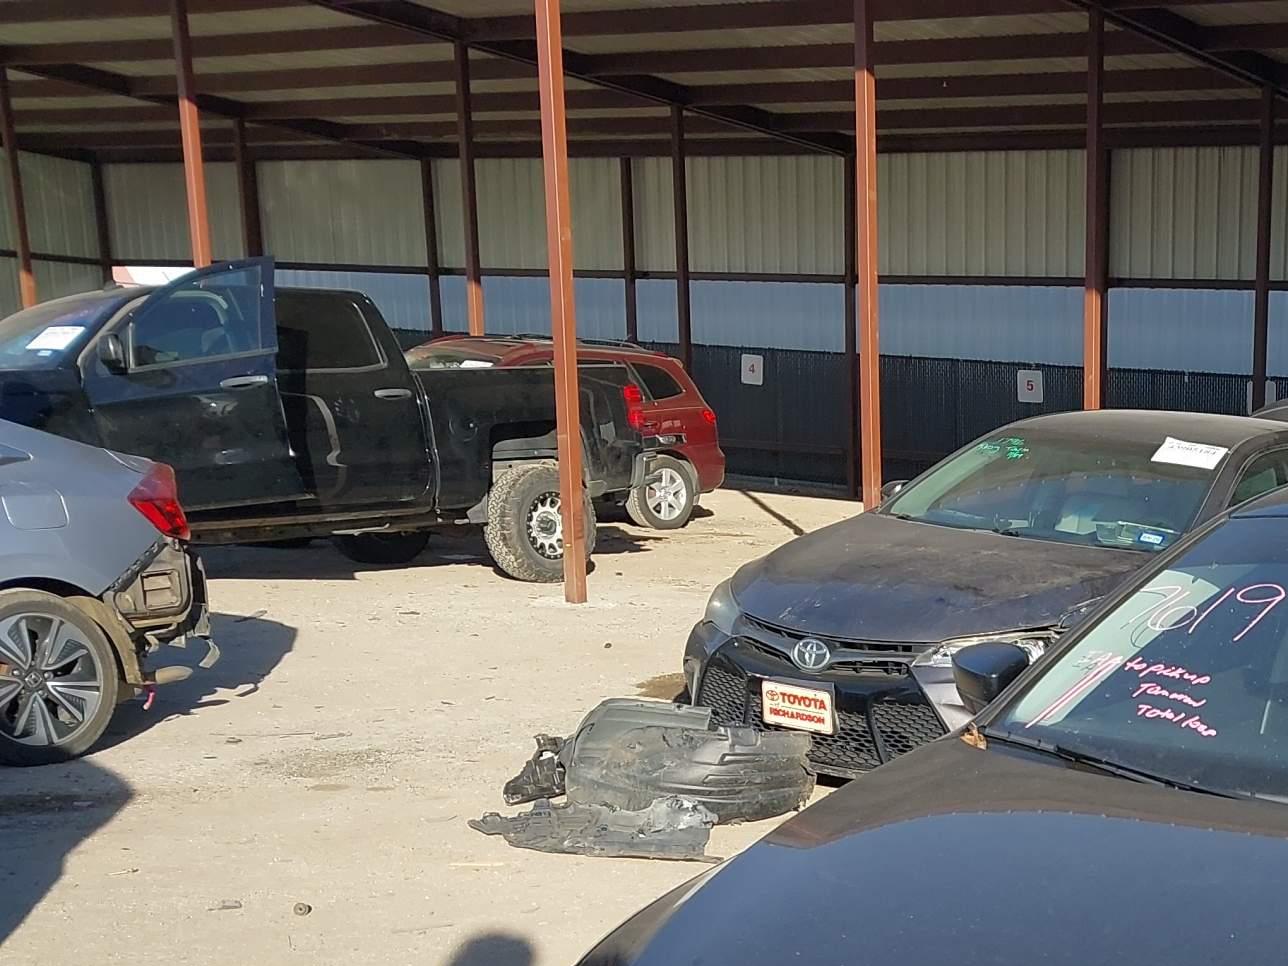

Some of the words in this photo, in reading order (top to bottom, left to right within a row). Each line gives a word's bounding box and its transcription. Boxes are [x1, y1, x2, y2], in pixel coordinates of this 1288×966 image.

[748, 363, 756, 374] 4
[1026, 379, 1034, 392] 5
[779, 691, 828, 711] TOYOTA
[768, 706, 825, 725] RICHARDSON
